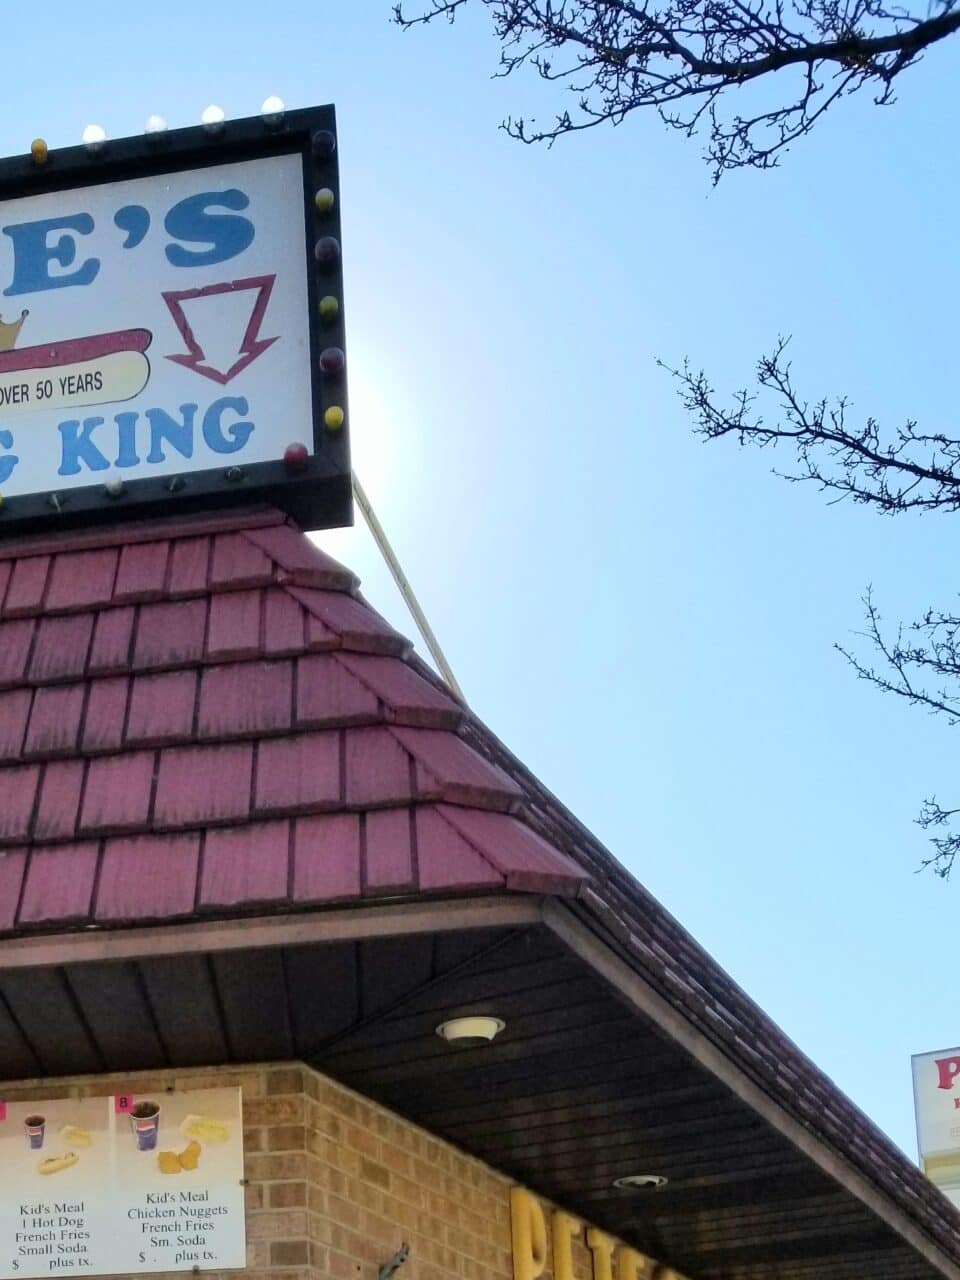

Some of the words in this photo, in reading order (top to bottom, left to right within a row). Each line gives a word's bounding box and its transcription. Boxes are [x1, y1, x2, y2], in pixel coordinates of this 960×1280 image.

[36, 379, 53, 400] 50
[59, 370, 103, 396] YEARS
[56, 396, 256, 477] KING
[119, 1096, 128, 1109] 8
[146, 1192, 176, 1204] Kid's
[179, 1190, 209, 1202] Meal
[20, 1203, 51, 1216] Kid's
[54, 1201, 85, 1214] Meal
[127, 1207, 176, 1220] Chicken
[179, 1205, 229, 1219] Nuggets
[32, 1217, 54, 1228] Hot
[58, 1216, 84, 1229] Dog
[142, 1221, 181, 1233] French
[185, 1219, 215, 1232] Fries
[15, 1230, 56, 1242] French
[60, 1228, 90, 1240] Fries
[176, 1234, 206, 1246] Soda
[18, 1243, 53, 1256] Small
[57, 1242, 87, 1254] Soda
[49, 1257, 75, 1271] plus
[175, 1250, 199, 1264] plus
